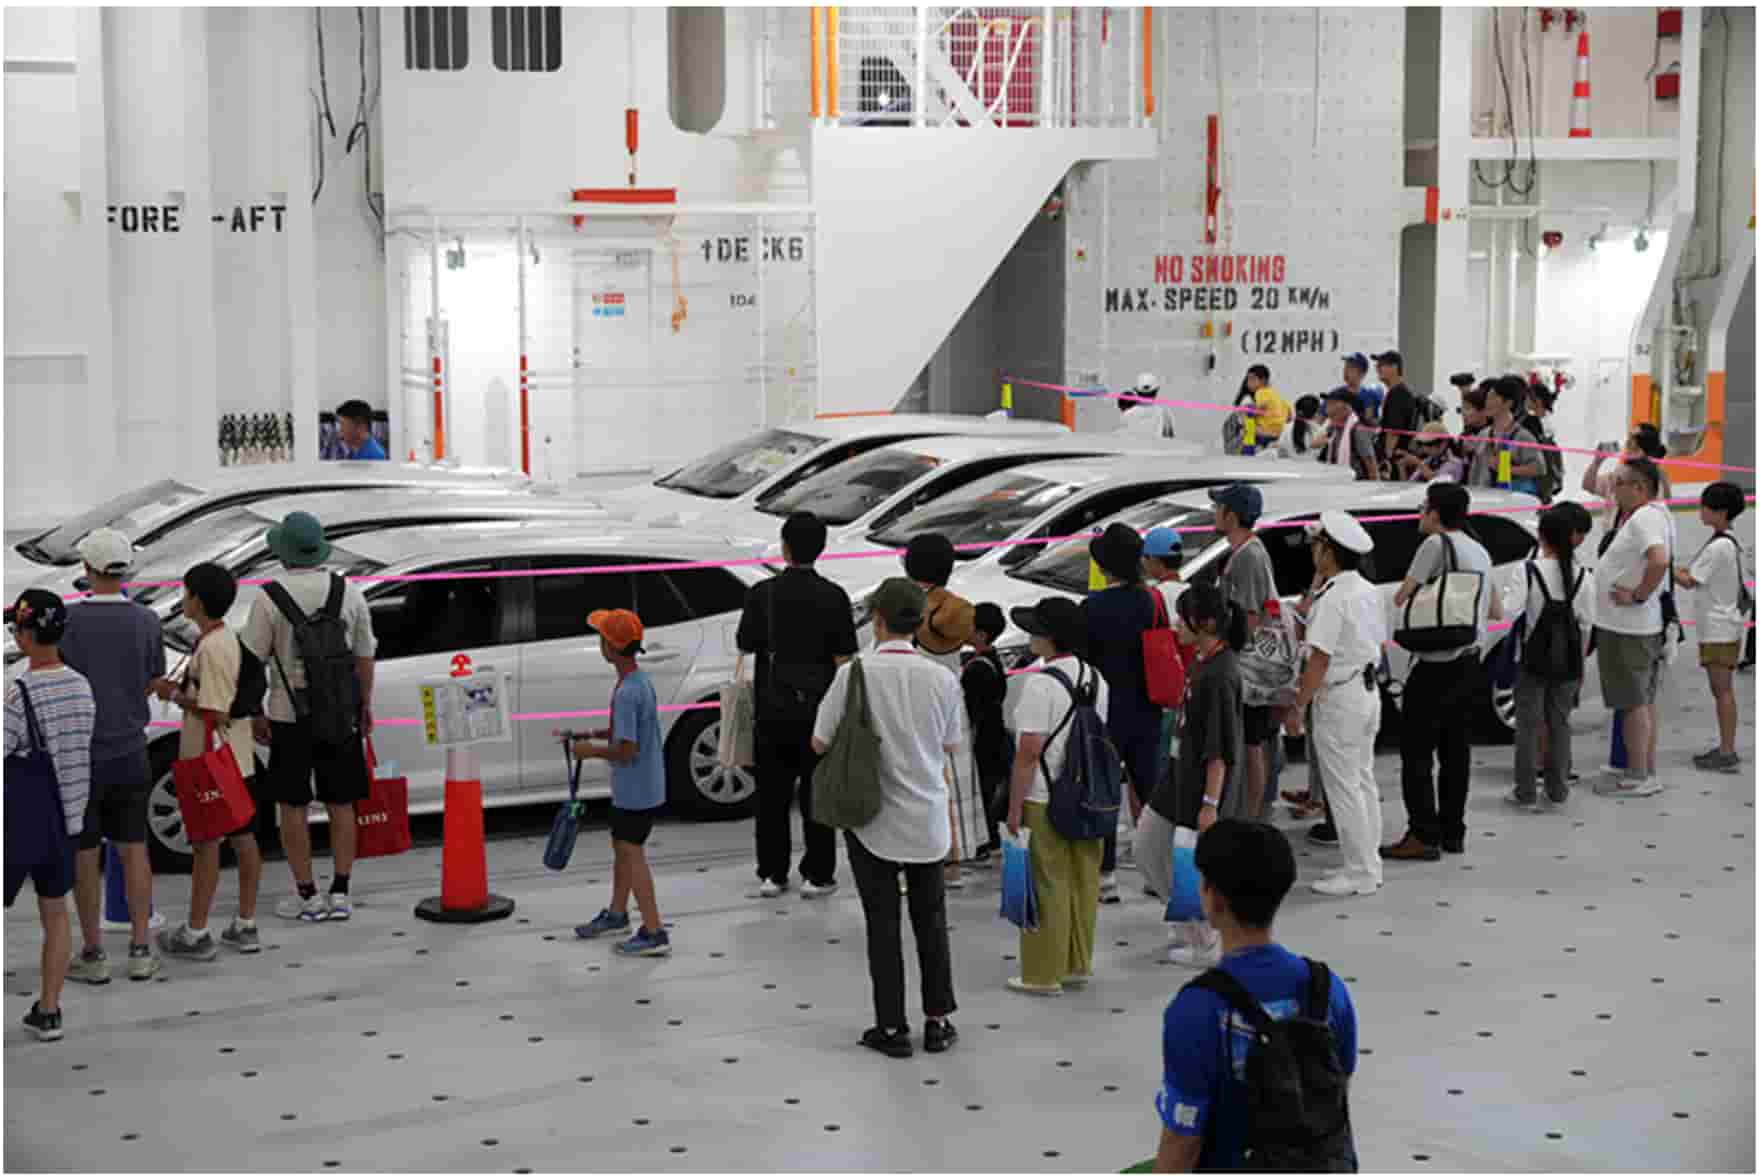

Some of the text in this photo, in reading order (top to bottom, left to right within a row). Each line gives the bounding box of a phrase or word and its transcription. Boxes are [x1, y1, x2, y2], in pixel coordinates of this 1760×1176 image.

[1154, 255, 1286, 284] NO SMOKING
[1164, 287, 1238, 311] SPEED
[1250, 287, 1280, 311] 20
